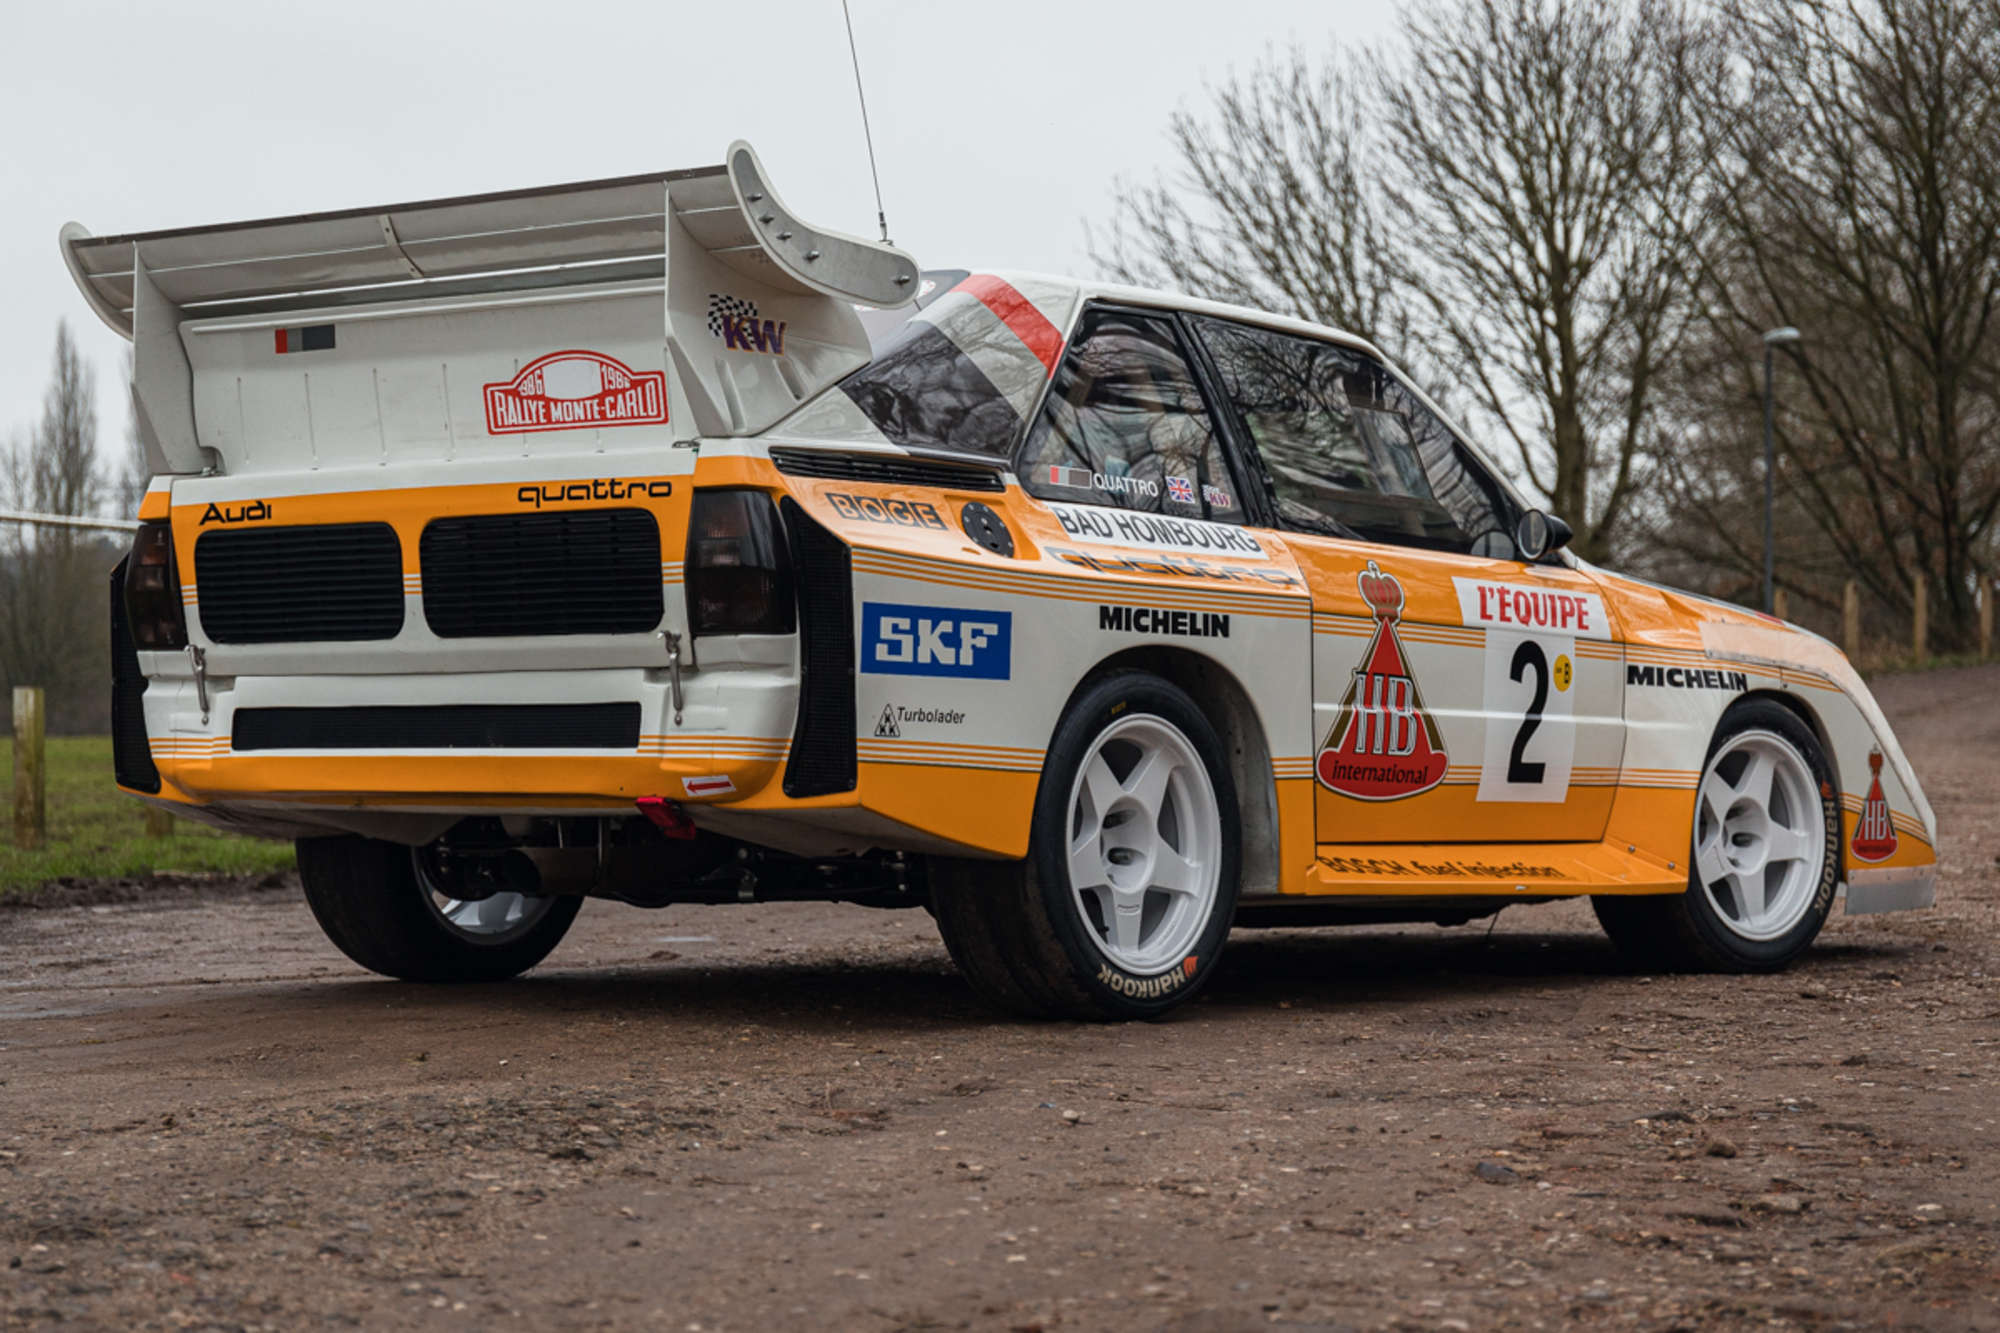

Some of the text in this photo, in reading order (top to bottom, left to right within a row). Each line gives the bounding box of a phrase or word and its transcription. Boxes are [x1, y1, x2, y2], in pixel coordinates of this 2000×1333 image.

[722, 314, 786, 357] KW
[494, 380, 659, 427] RALLYE MONTE-CARLO
[518, 478, 672, 508] quattro
[1093, 473, 1159, 498] QUATTRO
[199, 500, 272, 526] Audi
[828, 494, 945, 529] BOGE
[1052, 506, 1263, 553] BAD HOMBOURG
[1043, 545, 1300, 585] quattro
[1098, 604, 1230, 638] MICHELIN
[875, 616, 999, 667] SKF
[1626, 664, 1748, 693] MICHELIN
[897, 706, 966, 725] Turbolader
[1354, 672, 1419, 757] HB
[1507, 640, 1549, 784] 2
[1331, 760, 1429, 785] international
[1864, 800, 1888, 841] HB
[1315, 855, 1419, 876] BOSCH
